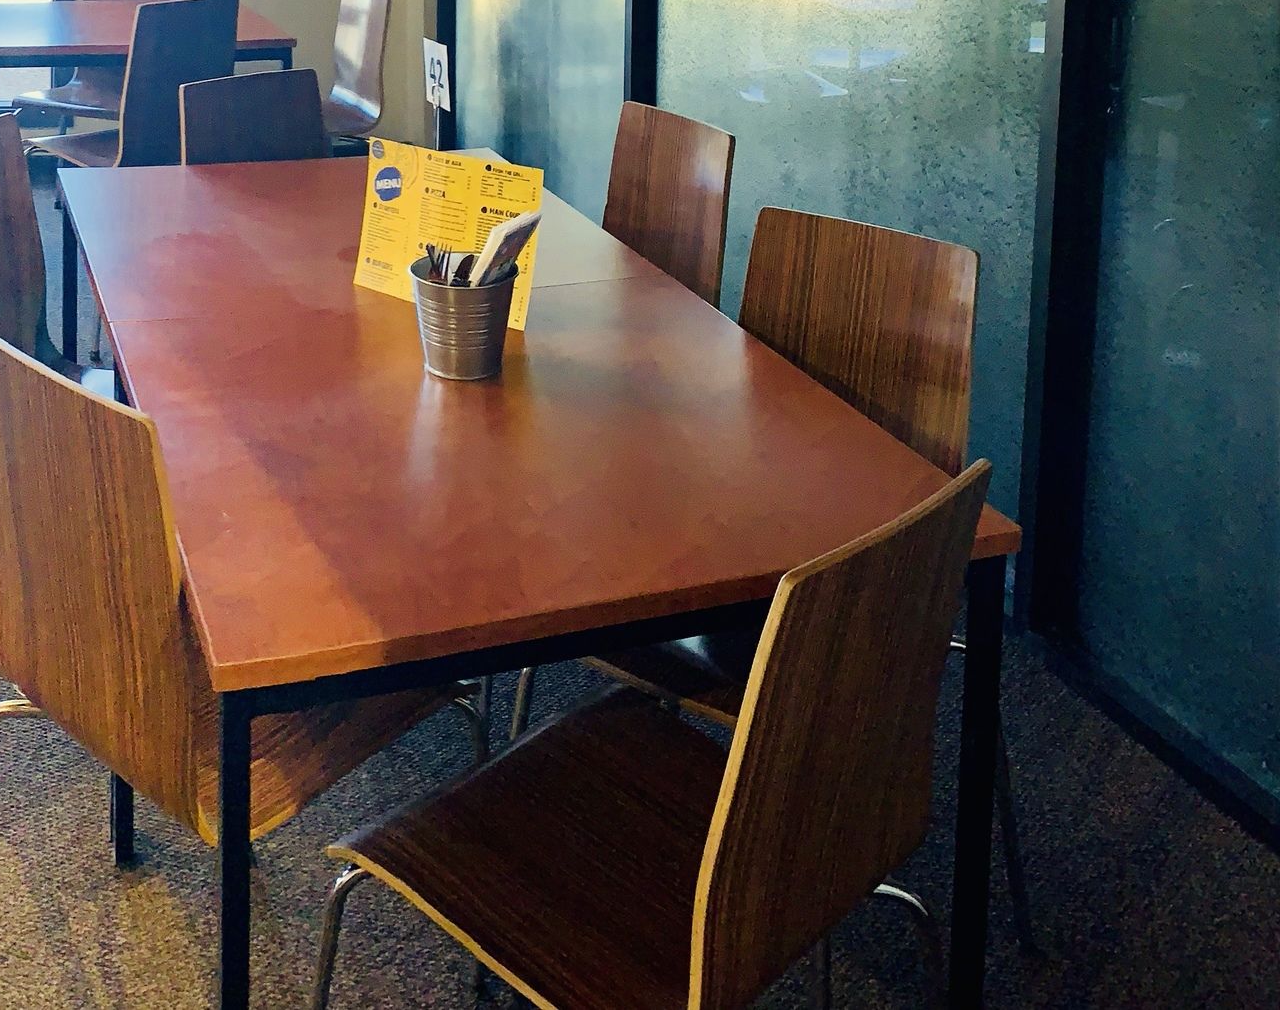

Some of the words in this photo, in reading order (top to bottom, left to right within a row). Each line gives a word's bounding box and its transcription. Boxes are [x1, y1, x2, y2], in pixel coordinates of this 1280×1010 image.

[429, 57, 444, 89] 42
[376, 177, 402, 191] MENU
[489, 207, 505, 217] MAIN
